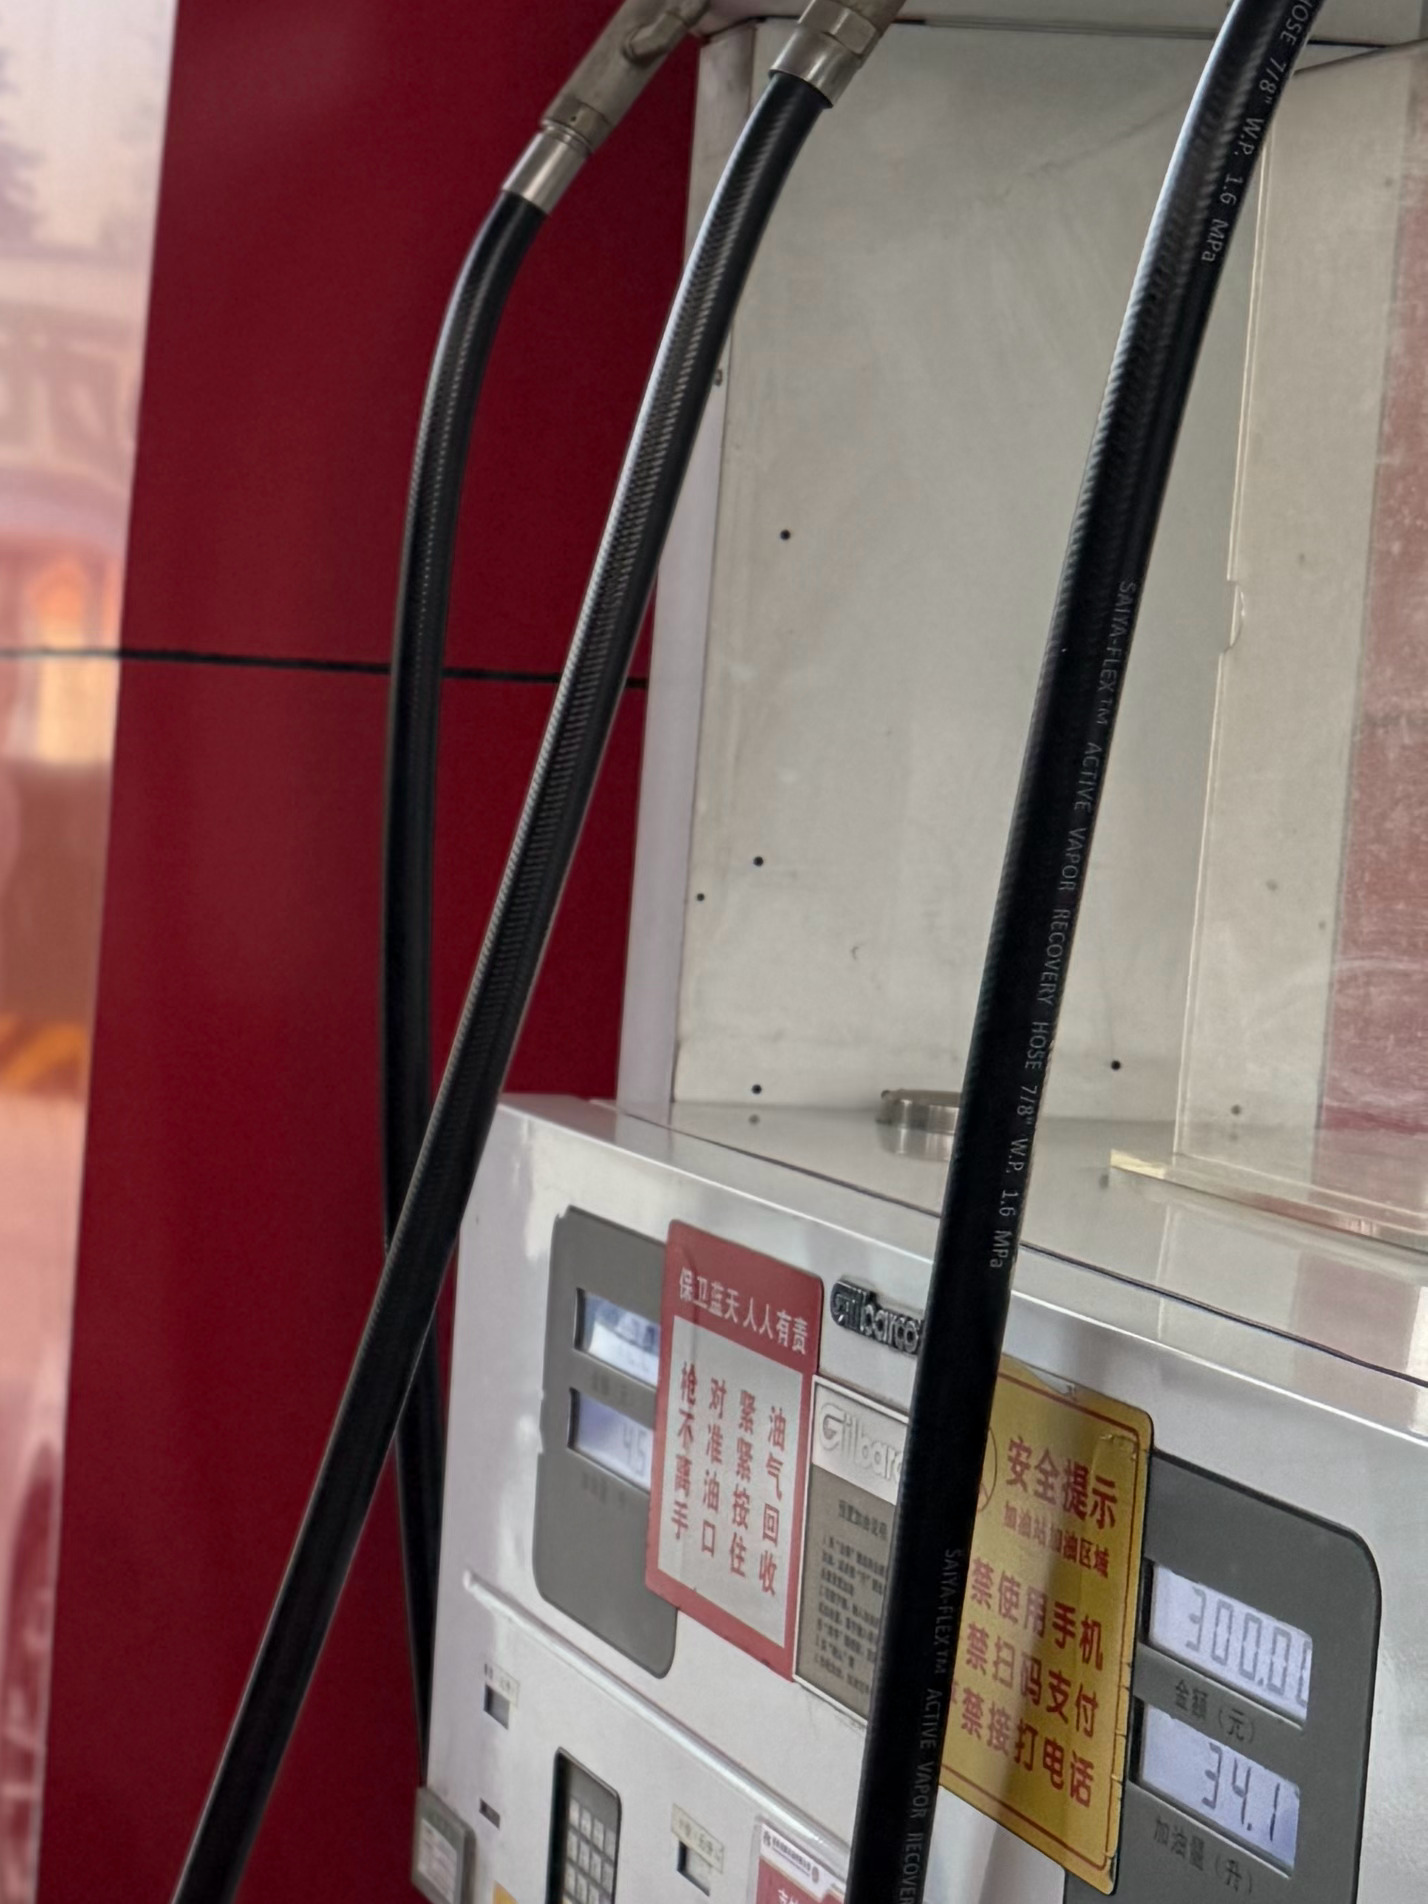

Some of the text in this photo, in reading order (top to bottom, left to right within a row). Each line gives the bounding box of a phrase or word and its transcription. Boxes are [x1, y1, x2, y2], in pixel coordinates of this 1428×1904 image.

[1219, 174, 1244, 205] 1.6
[1201, 218, 1230, 263] MPa
[1074, 741, 1102, 812] ACTIVE
[1057, 827, 1087, 891] VAPOR
[1037, 908, 1070, 1006] RECOVERY
[1025, 1020, 1048, 1071] HOSE
[999, 1188, 1019, 1218] 1.6
[989, 1228, 1011, 1268] MPa
[833, 1283, 921, 1354] Gilbarco
[700, 1377, 728, 1558] 对准油口
[820, 1402, 903, 1482] Gilbarc
[728, 1390, 757, 1578] 紧紧按住
[758, 1406, 788, 1597] 油气回收
[1007, 1437, 1117, 1531] 安全提示
[1004, 1501, 1109, 1580] 加油站加油区域
[920, 1688, 943, 1749] ACTIVE
[950, 1679, 1095, 1809] 禁接打电话
[910, 1761, 935, 1819] VAPOR
